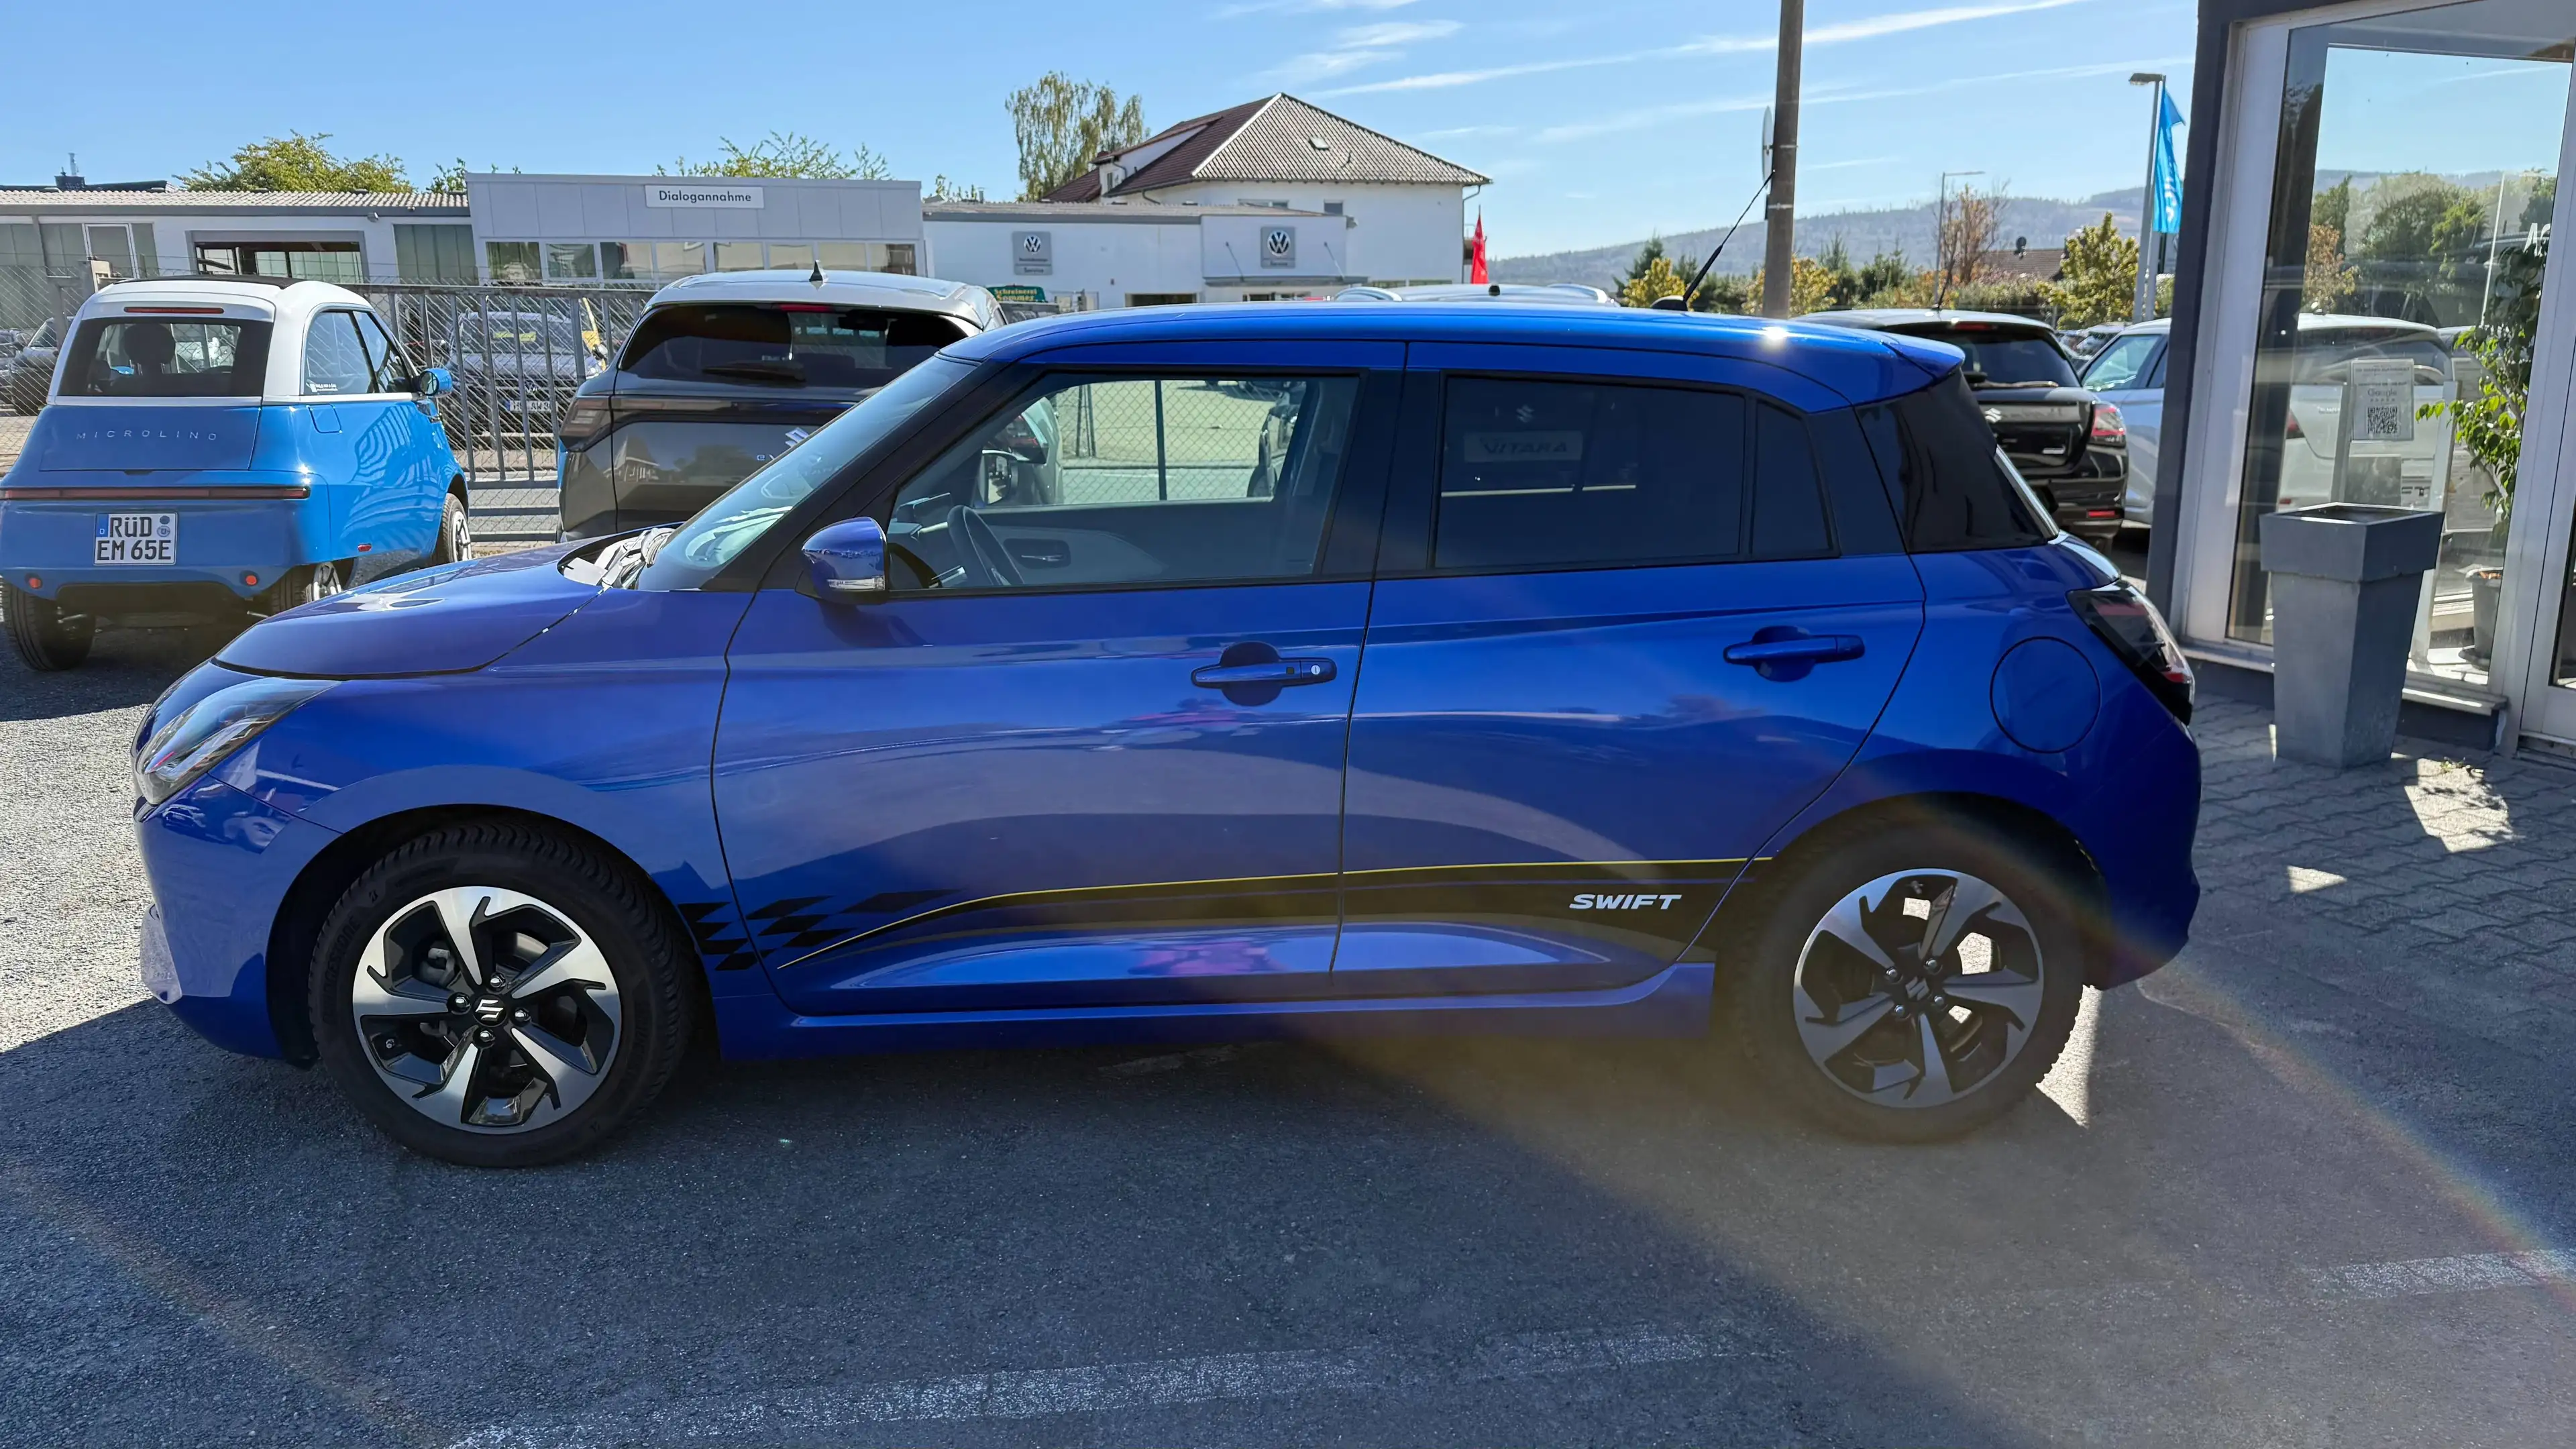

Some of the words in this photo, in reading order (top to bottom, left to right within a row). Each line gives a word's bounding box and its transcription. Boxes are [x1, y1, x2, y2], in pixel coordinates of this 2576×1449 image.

[659, 190, 751, 203] Dialogannahme
[76, 430, 217, 440] MICROLINO
[110, 517, 152, 537] RÜD
[97, 539, 125, 561] EM
[130, 539, 172, 560] 65E
[1569, 894, 1682, 910] SWIFT
